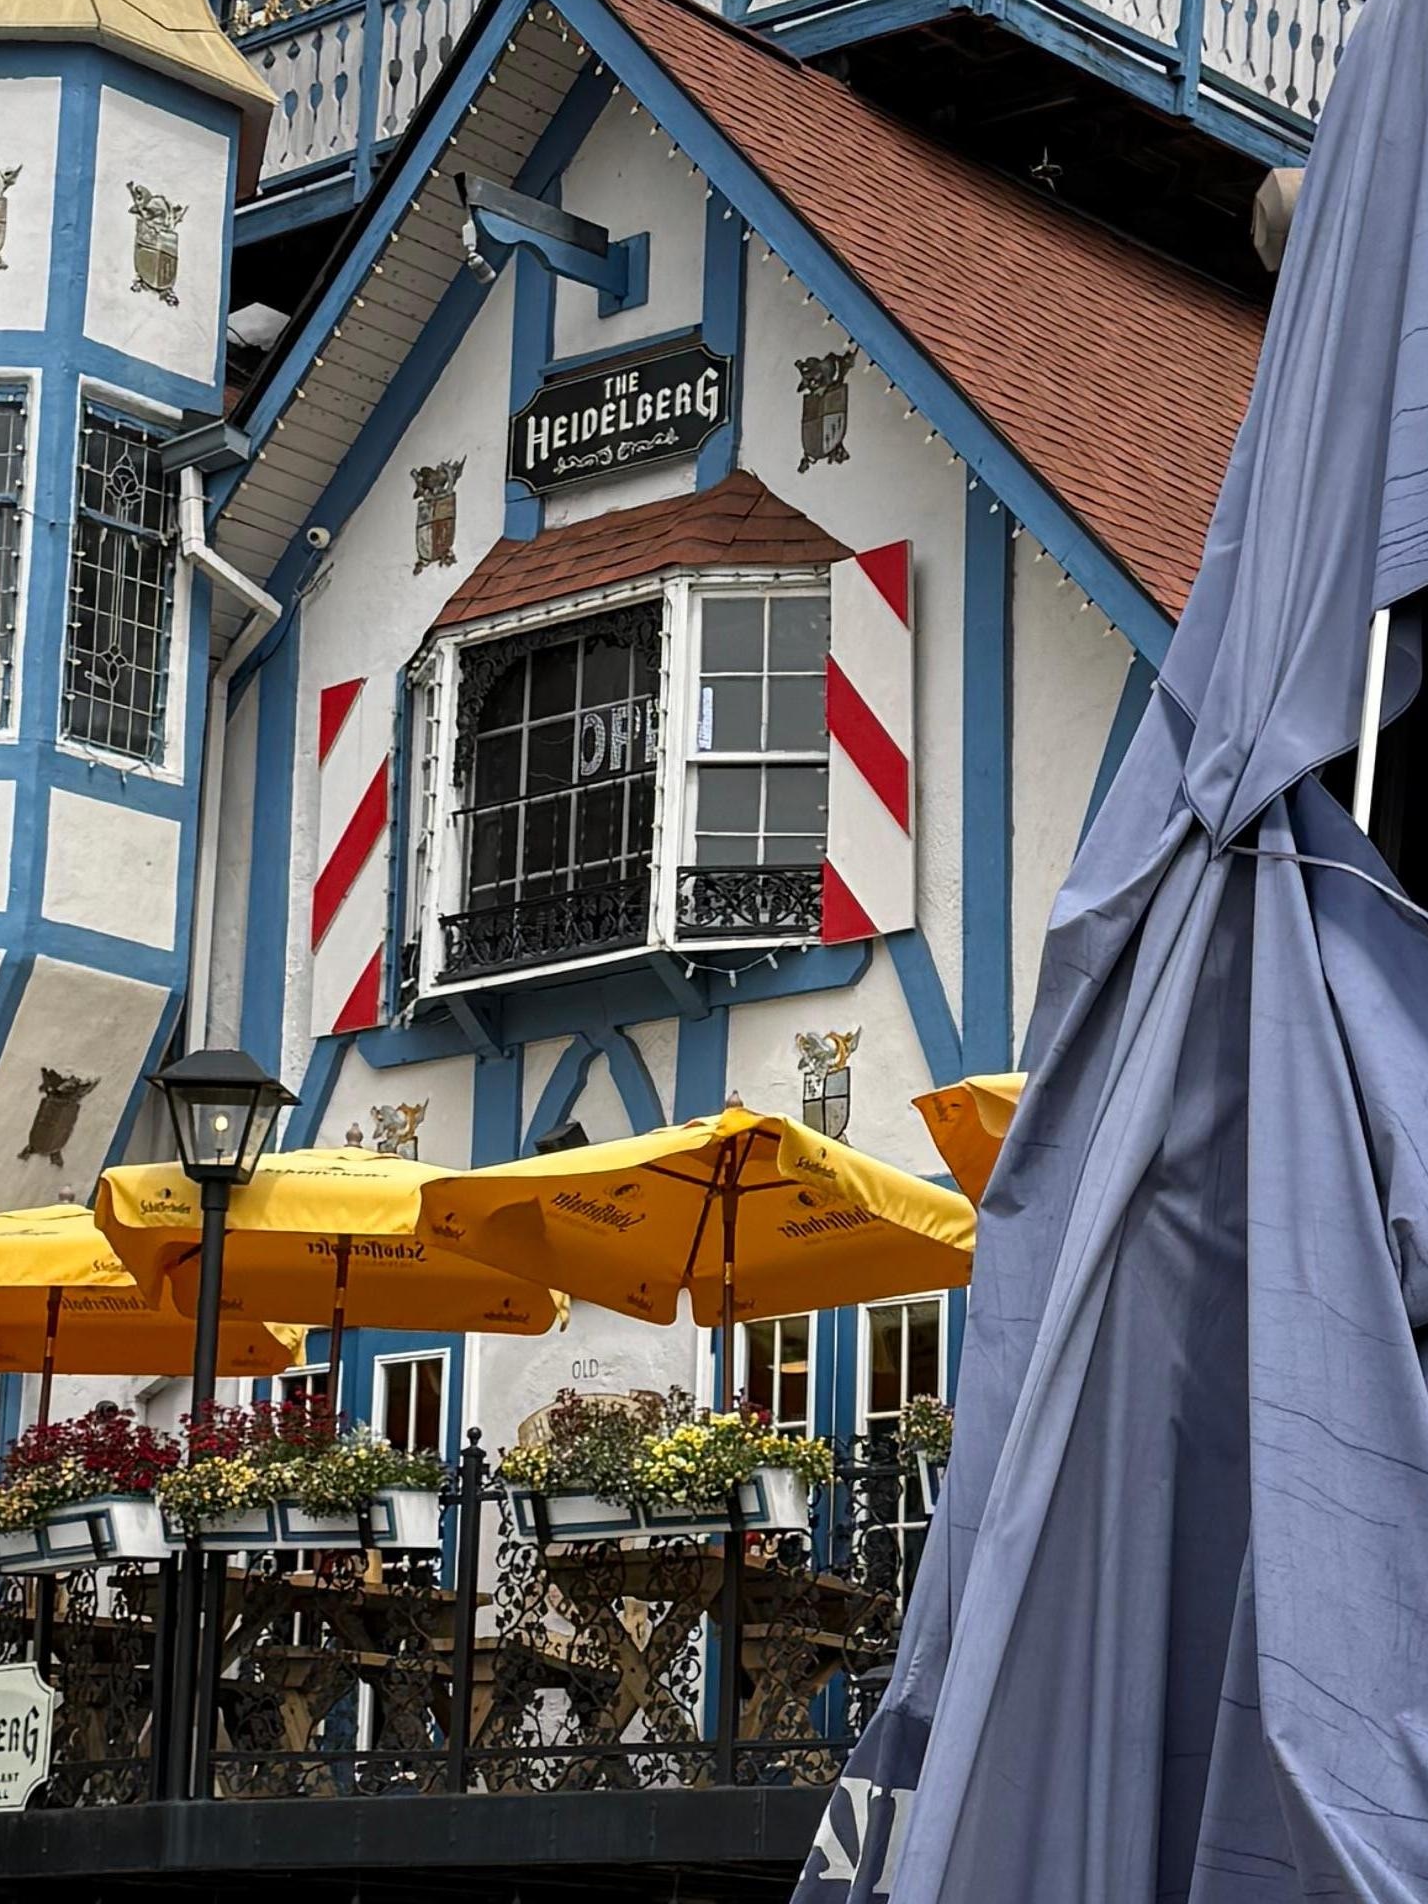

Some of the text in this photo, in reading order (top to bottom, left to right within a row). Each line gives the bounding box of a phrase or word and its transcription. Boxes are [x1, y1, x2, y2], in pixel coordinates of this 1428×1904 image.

[604, 371, 639, 399] THE
[525, 367, 719, 470] HEIDELBERG
[572, 1358, 599, 1380] OLD
